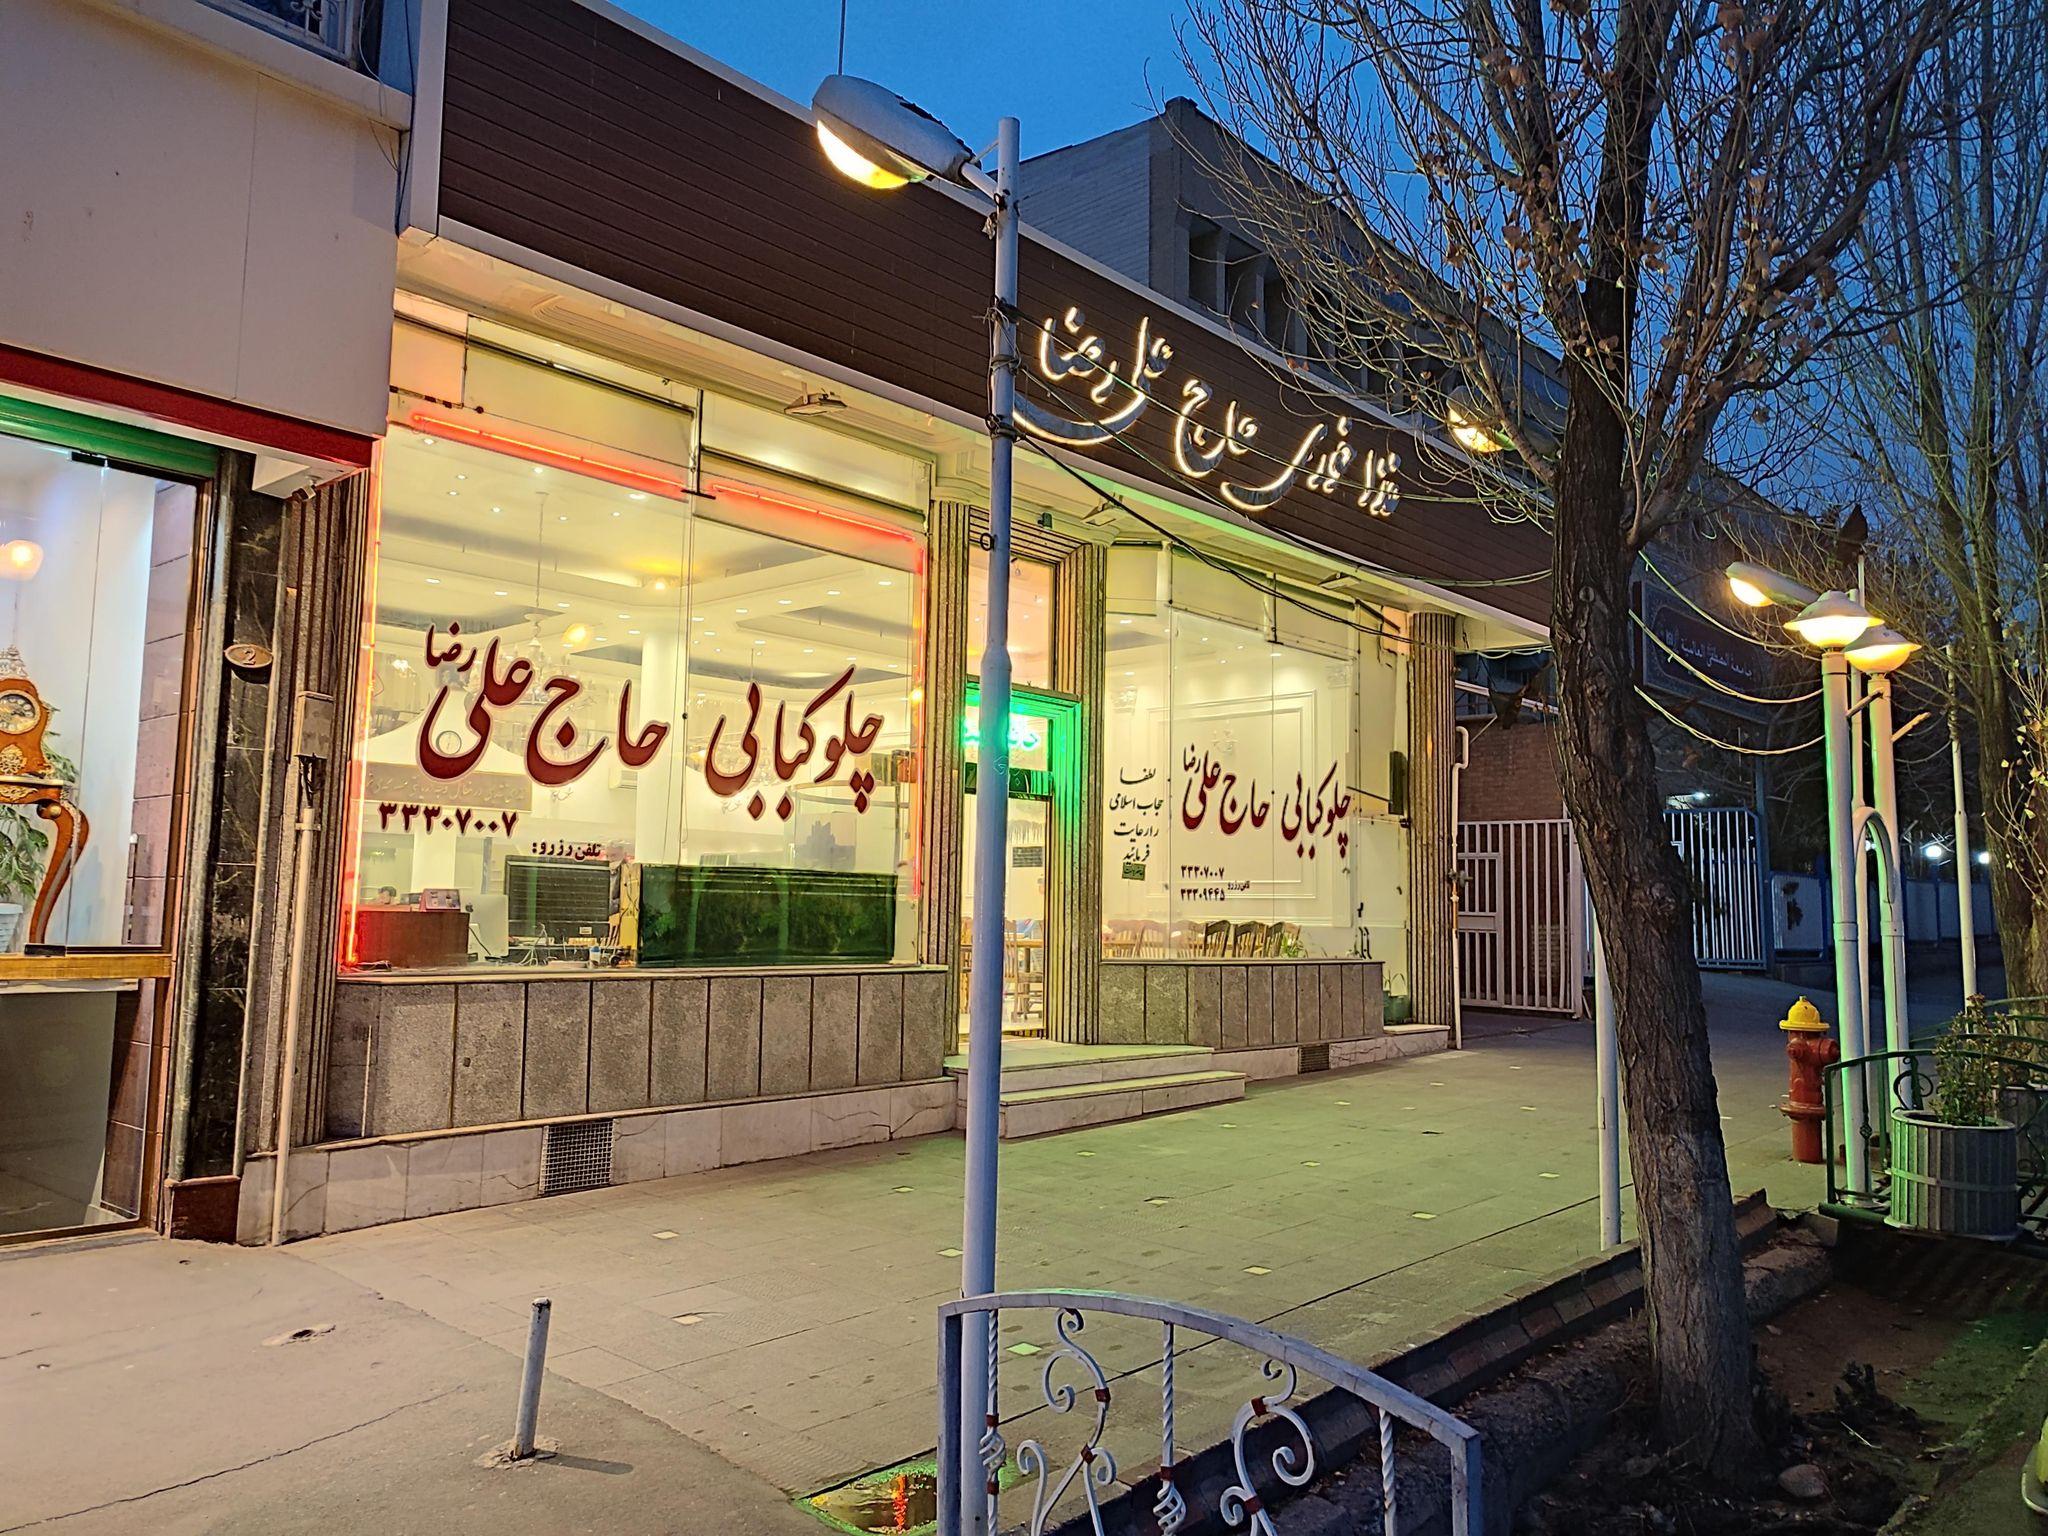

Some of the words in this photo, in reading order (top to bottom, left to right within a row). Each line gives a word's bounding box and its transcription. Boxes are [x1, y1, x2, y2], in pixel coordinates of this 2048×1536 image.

[1176, 379, 1258, 478] حاج
[525, 677, 671, 787] حاج
[1119, 768, 1157, 785] لطفا
[1109, 793, 1136, 810] اسلامی
[1136, 798, 1164, 816] حجاب
[1219, 772, 1271, 836] حاج
[378, 801, 518, 837] ۳۳۳۰۷۰۰۷
[1113, 822, 1149, 842] رعایت
[1149, 825, 1160, 837] را
[574, 842, 602, 860] تلفن
[1180, 865, 1225, 879] ۳۳۳۰۷۰۰۷
